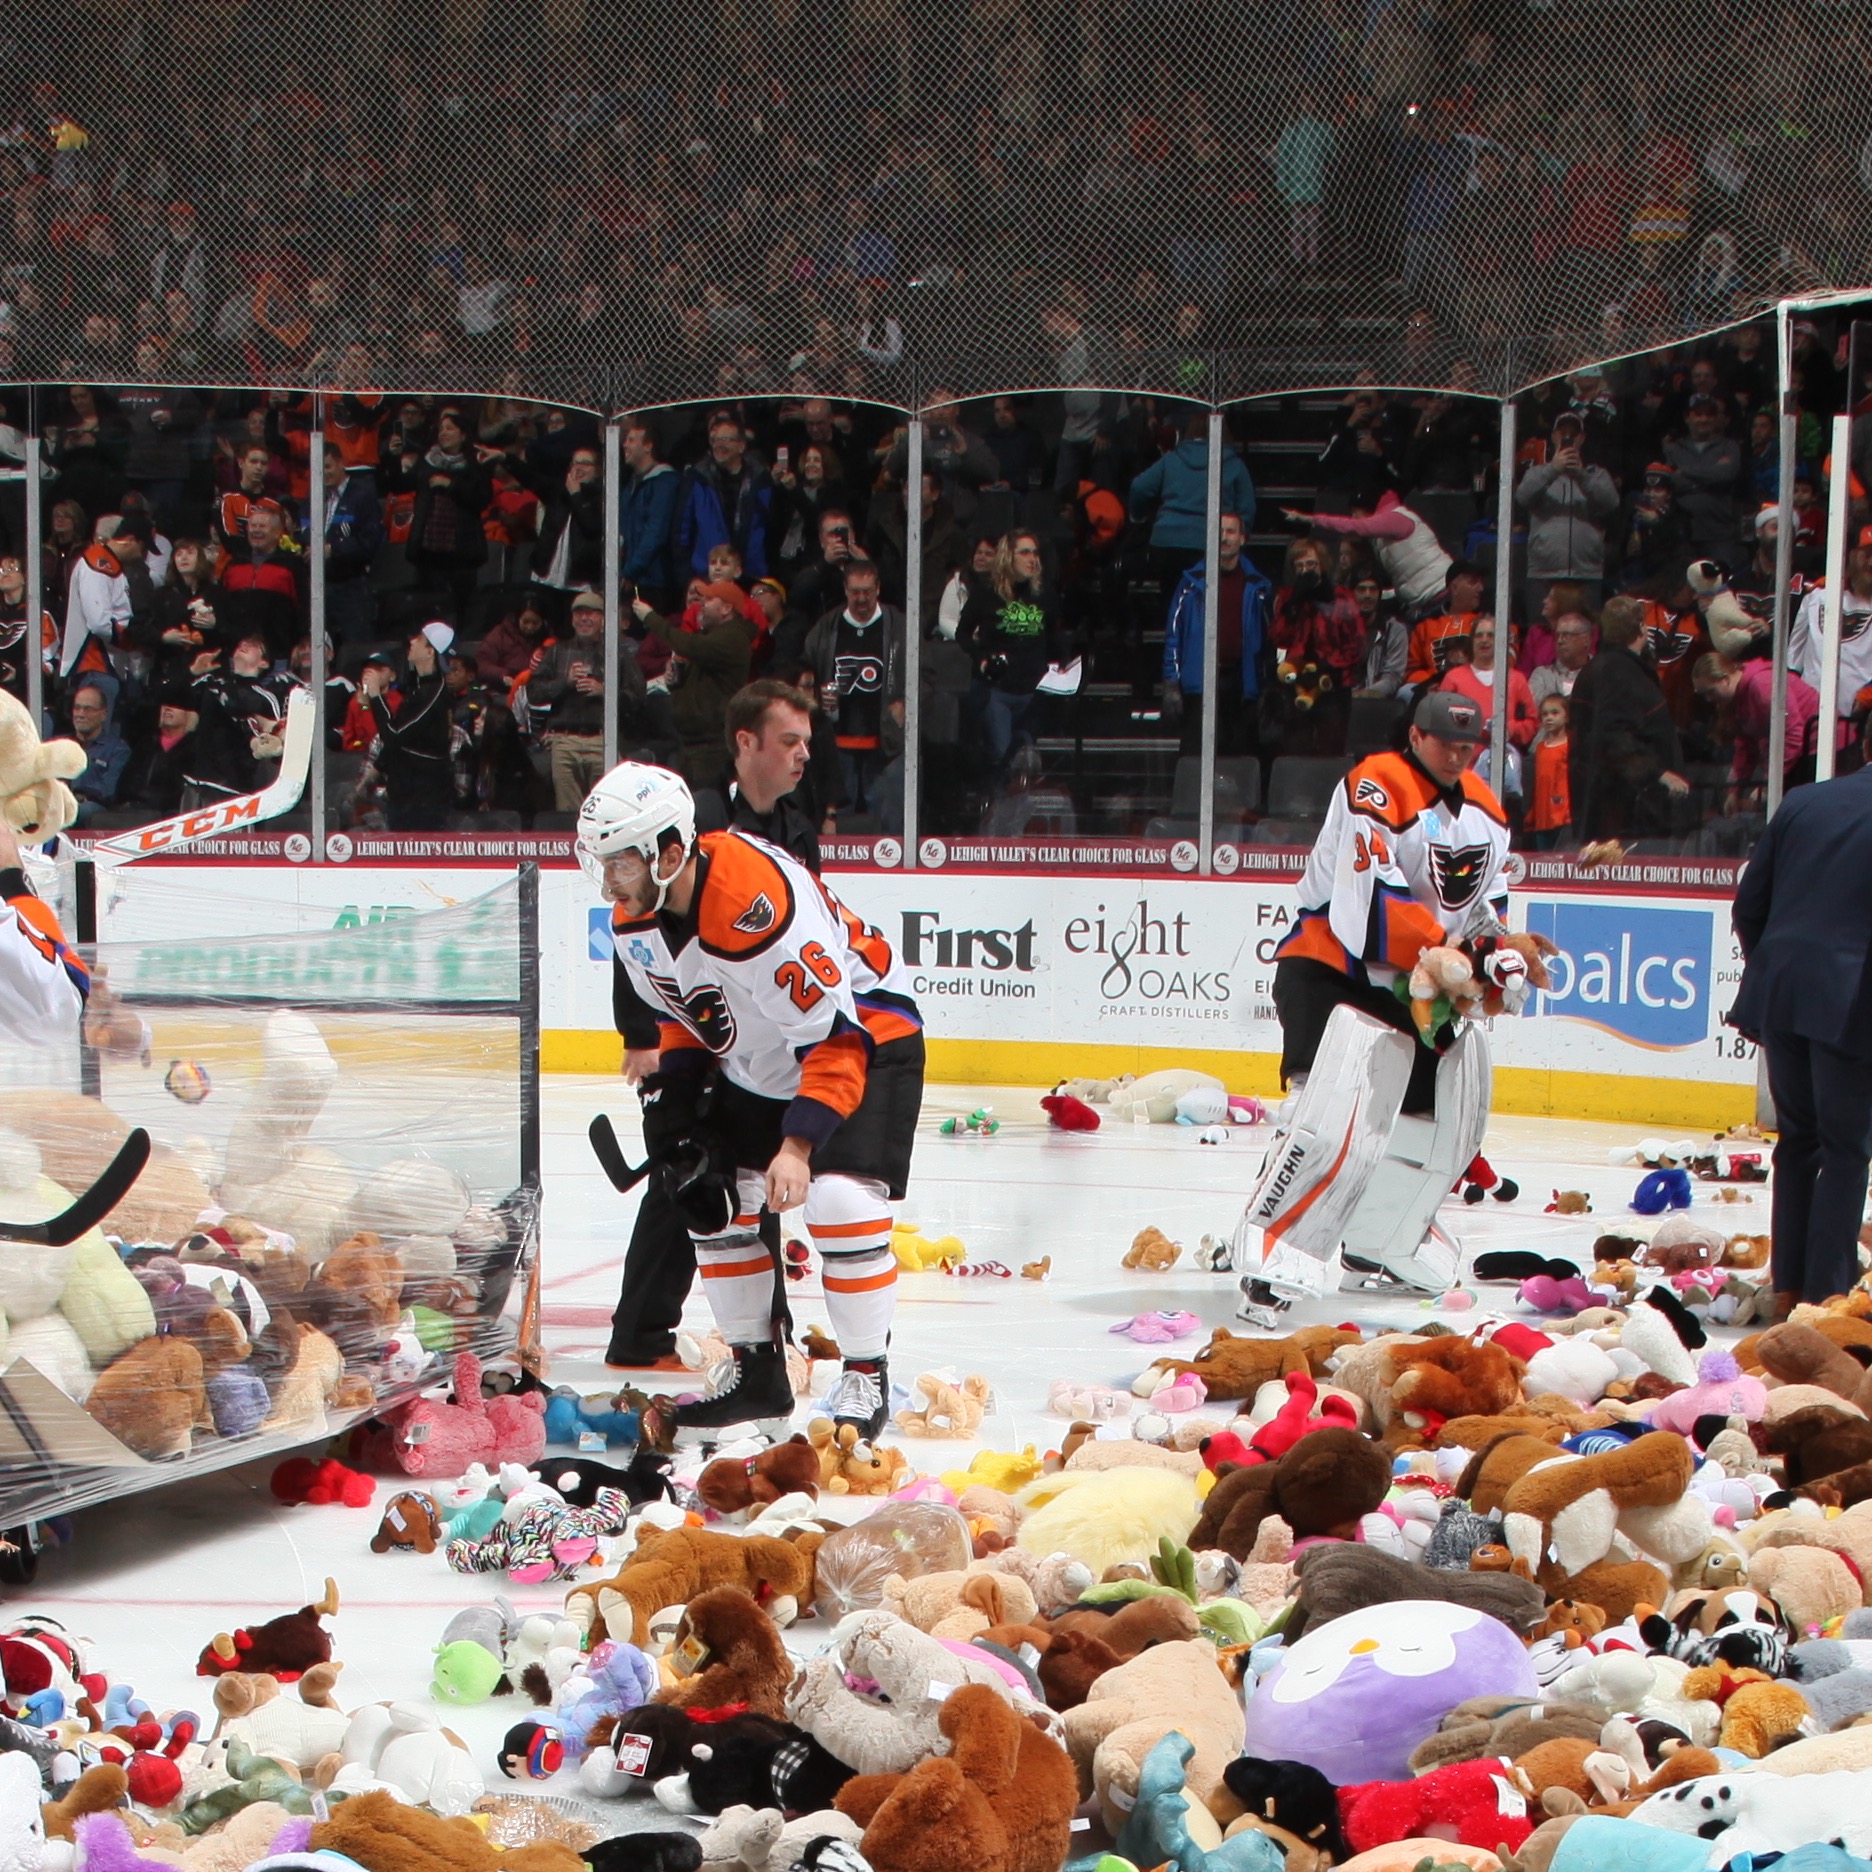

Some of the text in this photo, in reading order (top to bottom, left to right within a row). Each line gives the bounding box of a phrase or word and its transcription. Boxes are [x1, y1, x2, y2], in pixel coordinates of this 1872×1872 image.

[137, 796, 261, 850] CCM
[160, 841, 189, 855] LEAR
[192, 840, 227, 855] CHOICE
[229, 841, 248, 855] FOR
[250, 841, 280, 855] GLASS
[357, 841, 570, 856] LEHIGH VALLEY'S CLEAR CHOICE FOR GLASS
[838, 844, 870, 861] GLASS
[950, 846, 1166, 865] LEHIGH VALLEY'S CLEAR CHOICE FOR GLASS
[1353, 829, 1391, 873] 34
[1242, 854, 1279, 870] LEHIGH
[1530, 861, 1565, 878] LEHIGH
[1611, 865, 1642, 882] CLEAR
[1643, 866, 1679, 883] CHOICE
[1681, 867, 1701, 884] FOR
[1702, 867, 1733, 885] GLASS
[900, 911, 1037, 972] First
[774, 940, 842, 1013] 26
[1139, 969, 1231, 1002] OAKS
[1536, 932, 1697, 1018] palcs
[1716, 968, 1742, 985] pub
[913, 976, 1036, 998] Credit Union
[1100, 1004, 1229, 1020] CRAFT DISTILLERS
[1253, 1005, 1279, 1021] HAND
[1714, 1035, 1759, 1061] 1.87
[1258, 1143, 1306, 1220] VAUGHN
